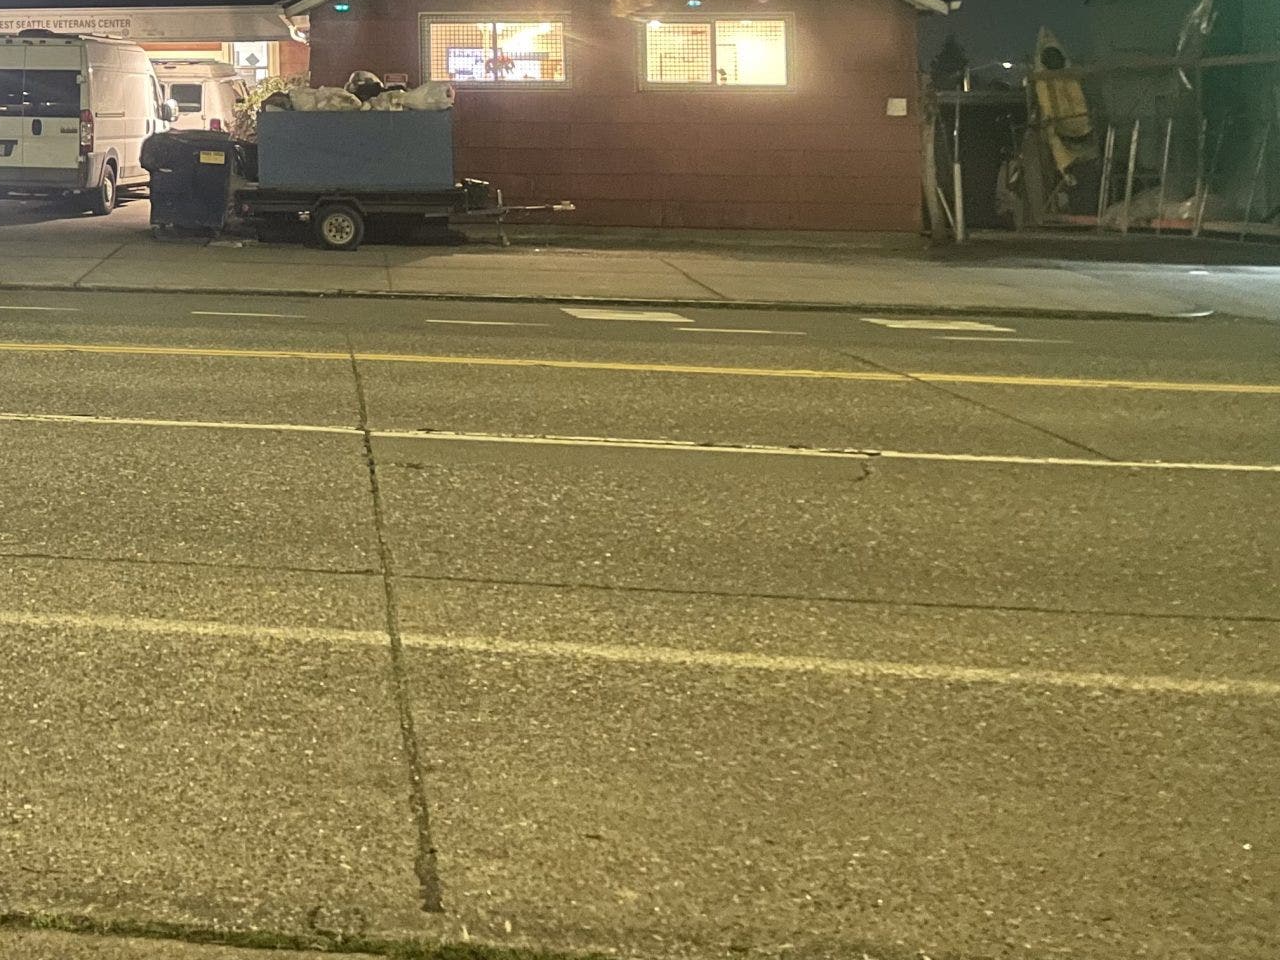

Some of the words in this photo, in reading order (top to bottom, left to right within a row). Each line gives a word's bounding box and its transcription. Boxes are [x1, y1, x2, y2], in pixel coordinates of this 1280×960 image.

[16, 19, 50, 29] SEATTLE
[53, 19, 96, 29] VETERANS
[98, 19, 131, 28] CENTER
